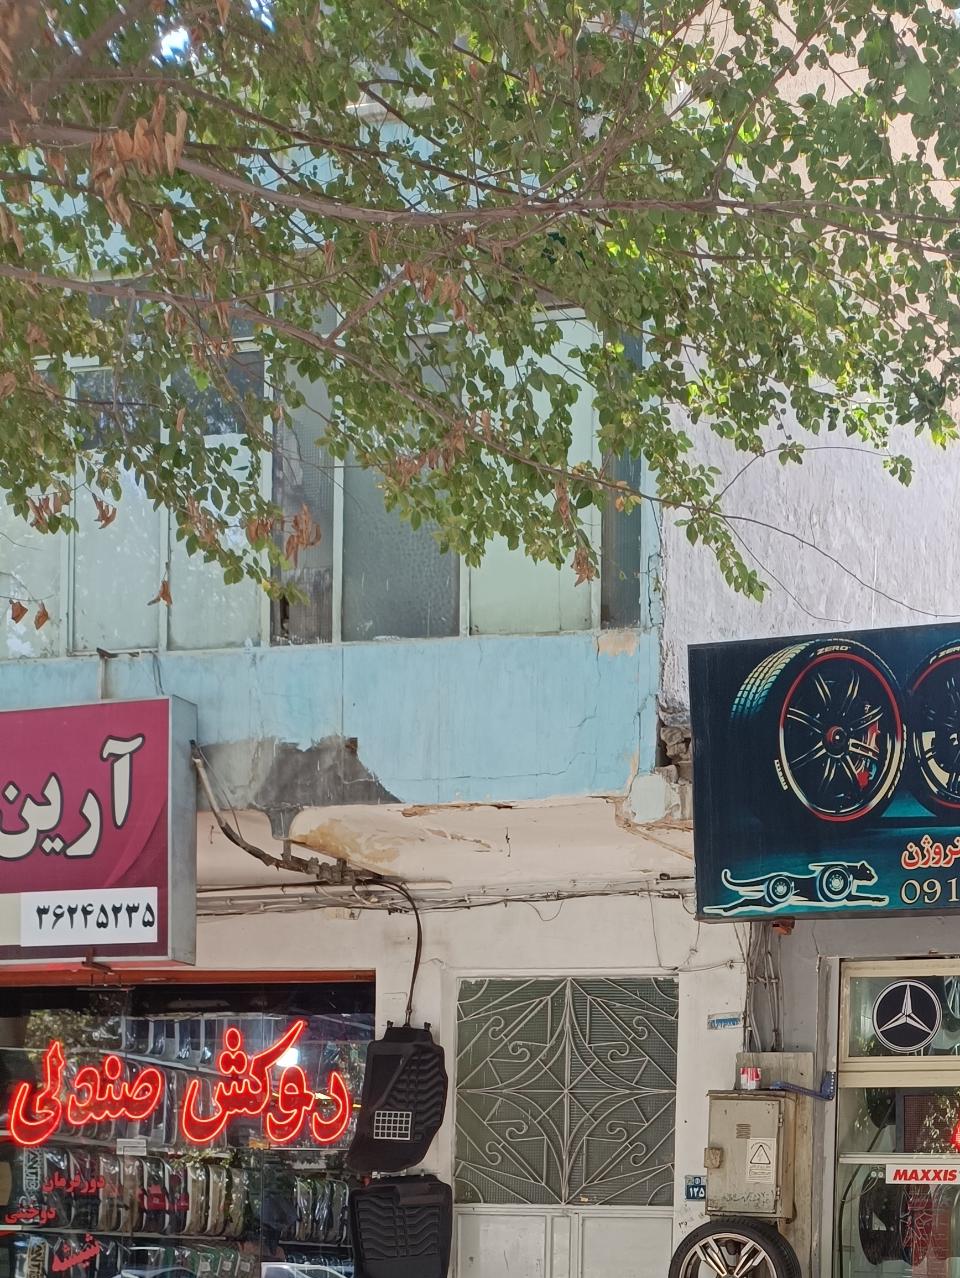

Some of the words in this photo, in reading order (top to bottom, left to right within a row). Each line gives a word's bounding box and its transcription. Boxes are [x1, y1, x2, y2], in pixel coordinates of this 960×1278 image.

[816, 645, 850, 656] ZERO
[36, 903, 156, 930] ۳۶۲۴۵۲۳۵
[9, 1040, 163, 1146] صندلی
[182, 1019, 350, 1143] روکش
[892, 1169, 958, 1181] MAXXIS
